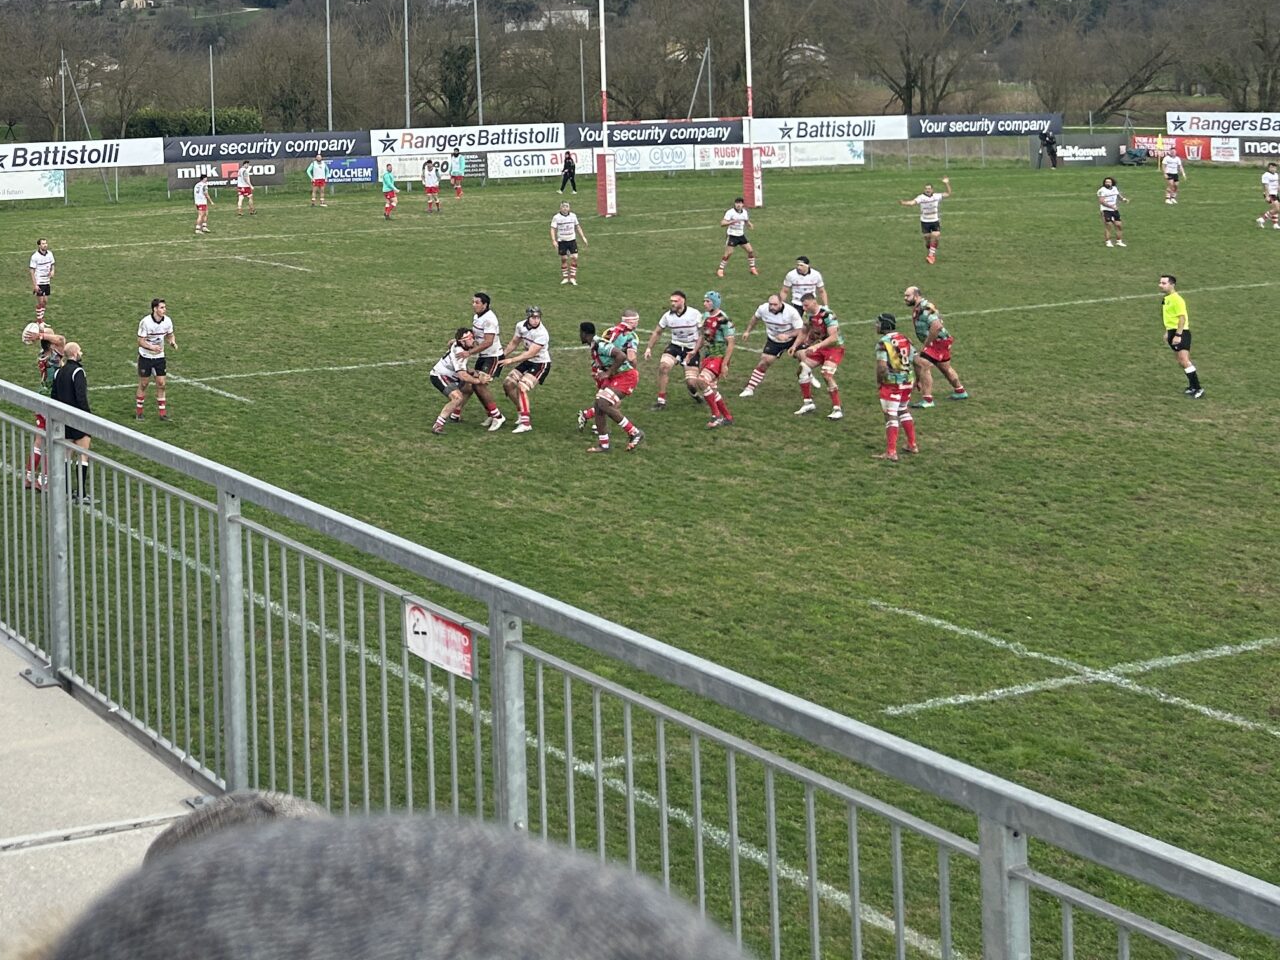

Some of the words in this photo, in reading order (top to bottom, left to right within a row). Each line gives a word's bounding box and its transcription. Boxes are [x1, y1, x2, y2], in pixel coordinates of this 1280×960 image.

[613, 127, 665, 143] security
[670, 125, 731, 141] company
[796, 120, 876, 138] Battistolli
[920, 119, 947, 133] Your
[949, 118, 995, 134] security
[997, 118, 1051, 133] company
[11, 143, 120, 167] Battistolli
[179, 141, 216, 157] Your
[220, 138, 281, 157] security
[285, 138, 356, 154] company
[714, 146, 741, 158] RUGBY
[177, 164, 219, 178] milk
